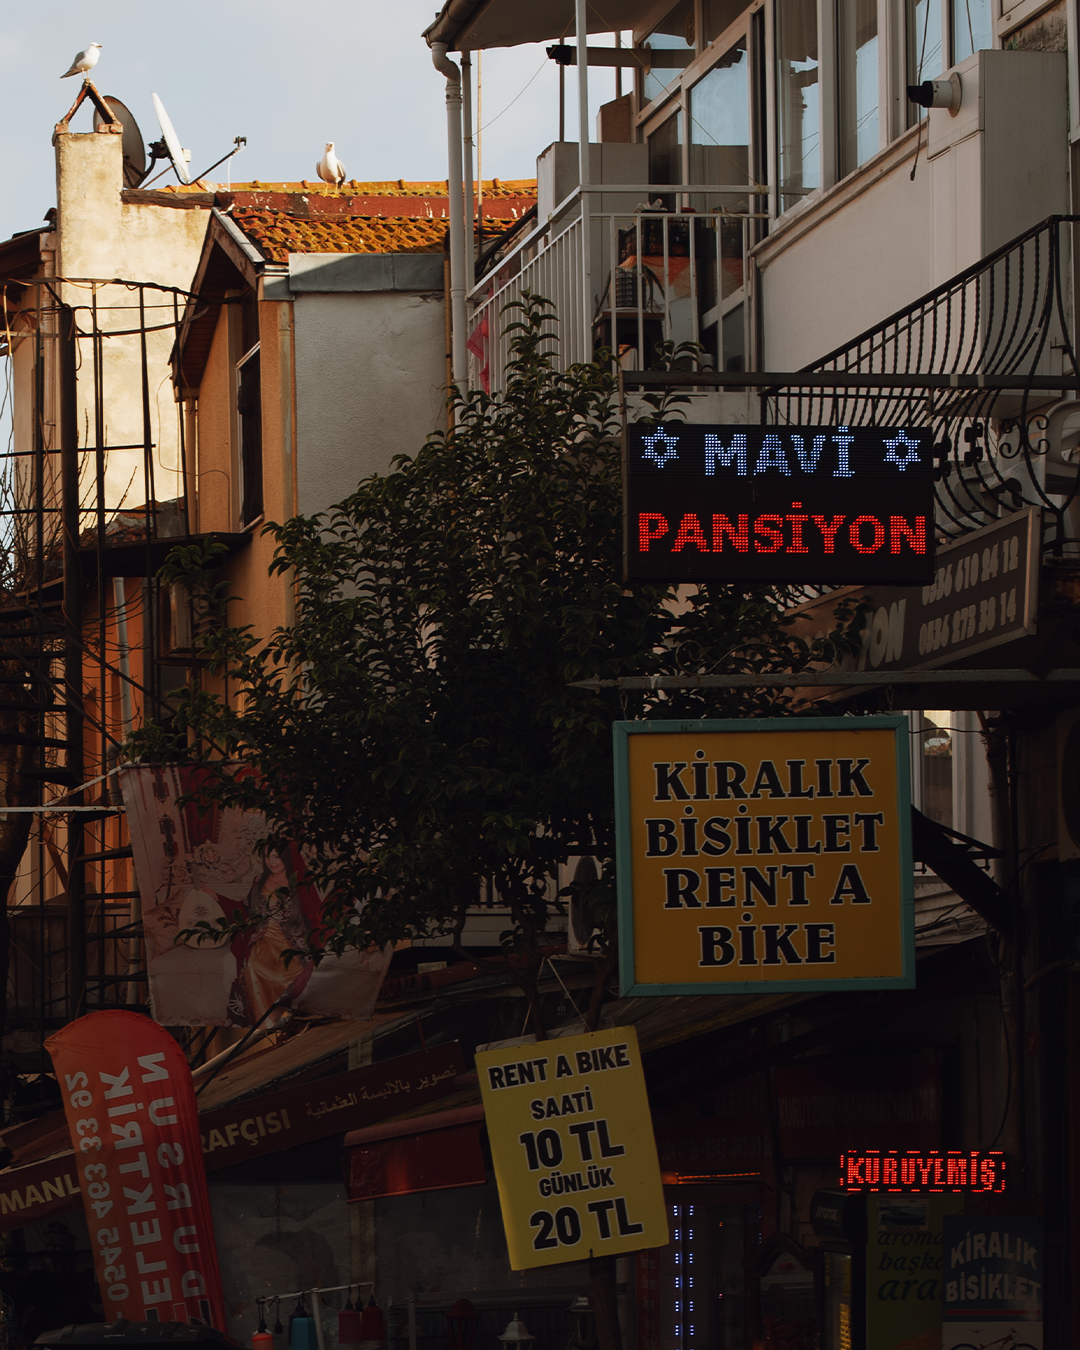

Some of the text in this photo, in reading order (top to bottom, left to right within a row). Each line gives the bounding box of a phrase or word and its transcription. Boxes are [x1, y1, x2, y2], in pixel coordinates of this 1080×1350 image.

[704, 425, 856, 478] MAVİ
[638, 501, 927, 556] PANSİYON
[653, 750, 874, 802] KİRALIK
[645, 805, 884, 858] BİSİKLET
[662, 864, 871, 910] RENT A
[698, 913, 836, 968] BİKE
[488, 1044, 631, 1091] RENT A BIKE
[531, 1086, 594, 1120] SAATİ
[520, 1119, 625, 1172] 10 TL
[538, 1166, 615, 1198] GÜNLÜK
[530, 1196, 643, 1251] 20 TL
[950, 1230, 1038, 1269] KİRALIK
[945, 1265, 1042, 1303] BİSİKLET
